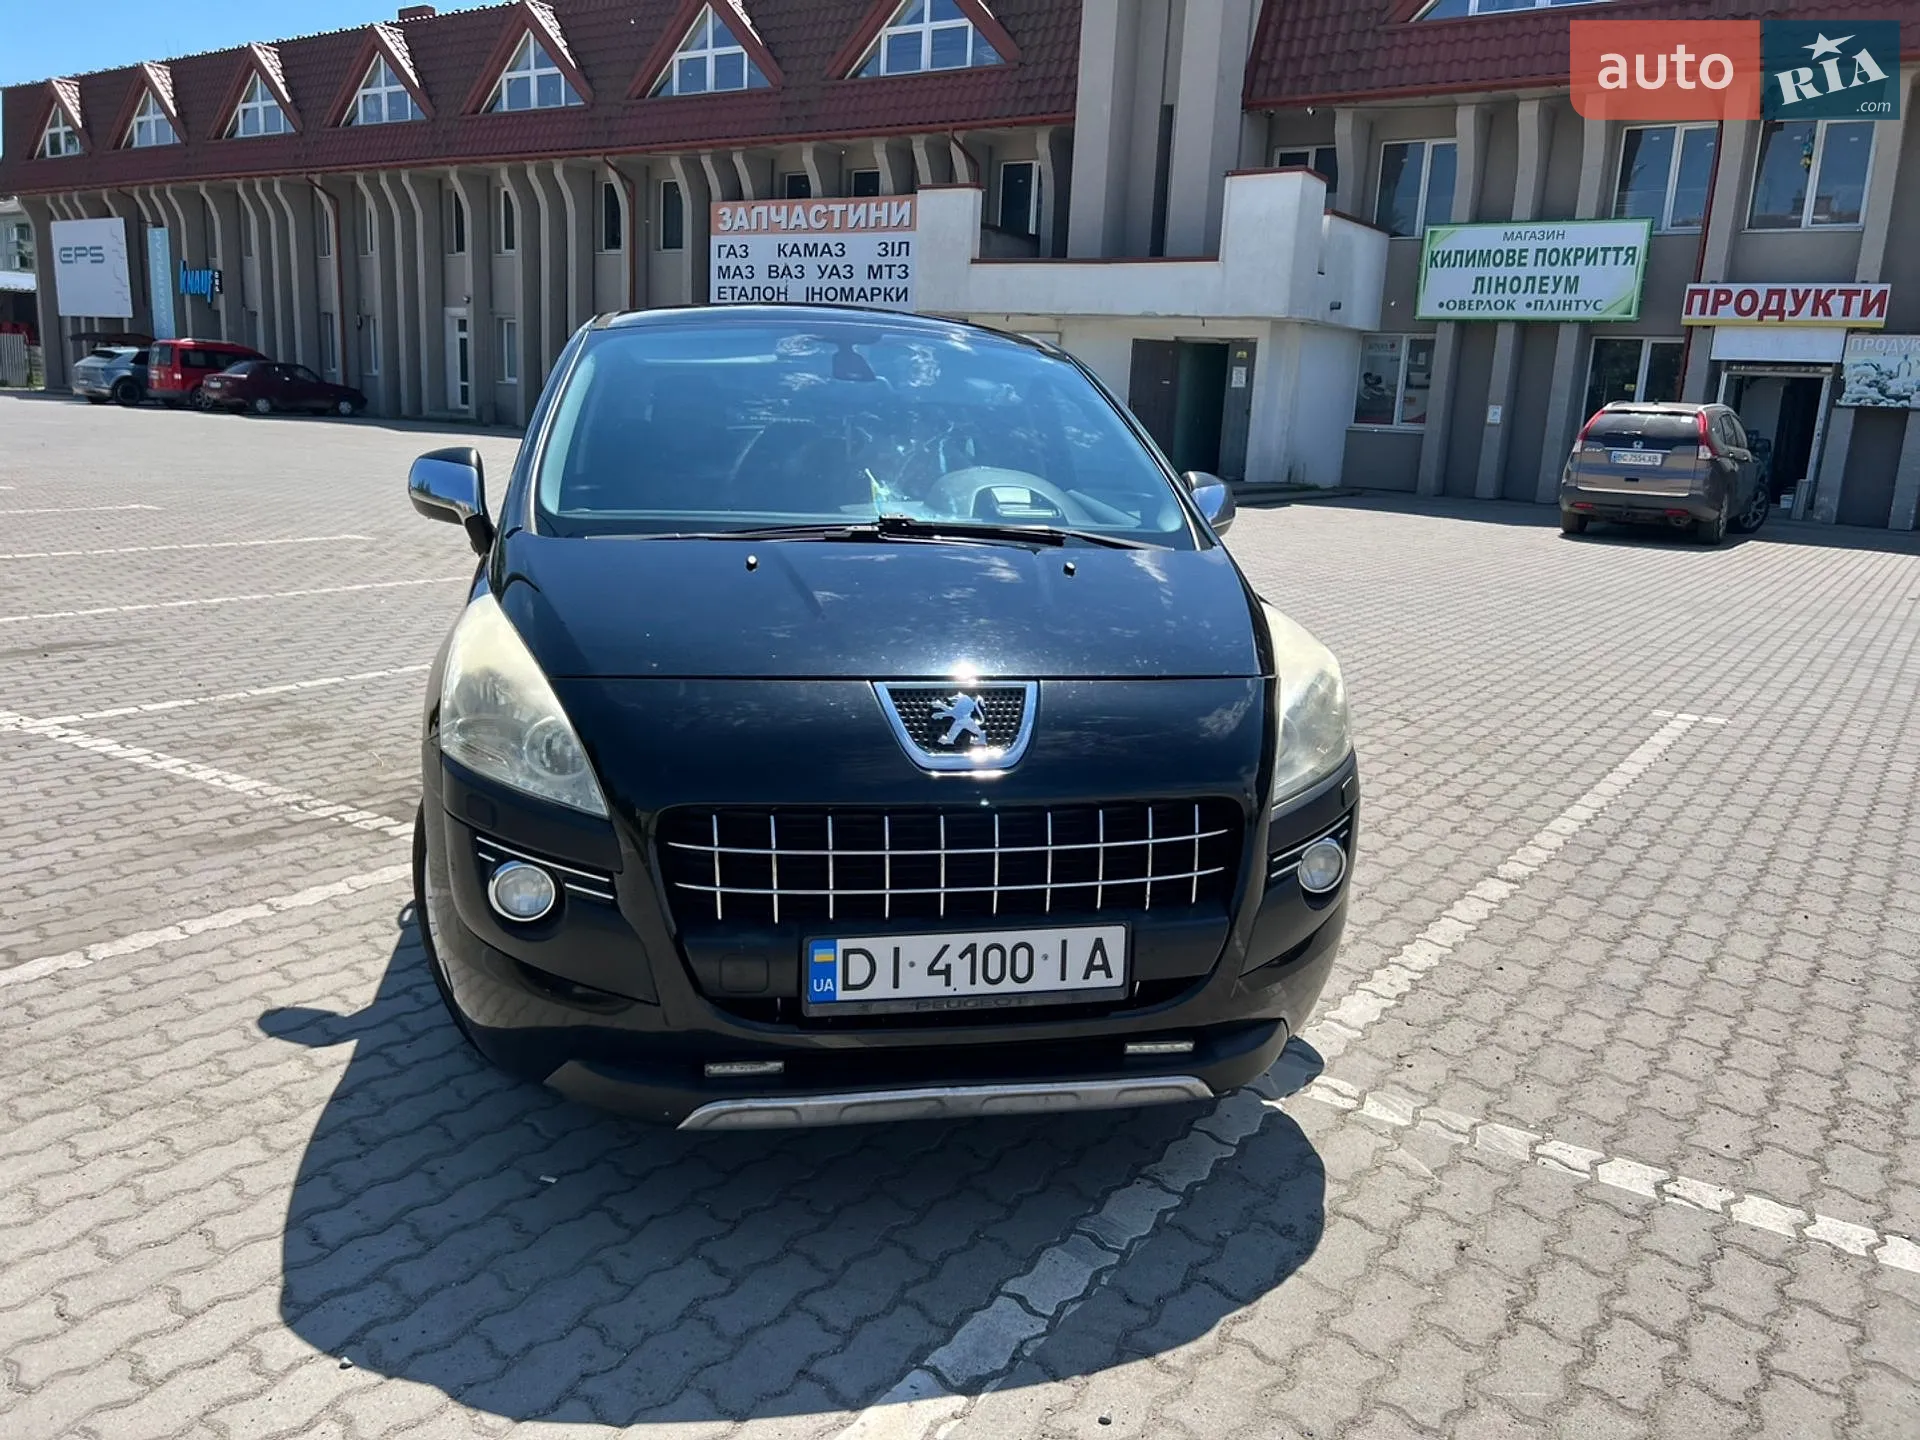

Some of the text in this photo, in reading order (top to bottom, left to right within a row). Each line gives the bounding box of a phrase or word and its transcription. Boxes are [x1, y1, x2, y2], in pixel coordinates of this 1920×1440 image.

[717, 200, 912, 231] ЗАПЧАСТИНИ
[1502, 230, 1566, 242] МАГАЗИН
[59, 246, 105, 264] EPS
[717, 241, 910, 259] ГАЗ КАМАЗ ЗІЛ
[1429, 246, 1637, 268] КИЛИМОВЕ ПОКРИТТЯ
[717, 264, 909, 280] МАЗ ВАЗ УАЗ МТЗ
[179, 260, 213, 303] KNAUF
[1471, 275, 1580, 295] ЛІНОЛЕУМ
[717, 286, 908, 302] ЕТАЛОН ІНОМАРКИ
[1684, 288, 1889, 322] ПРОДУКТИ
[841, 937, 1114, 992] DI 4100 IA
[813, 978, 835, 993] UA
[915, 997, 1027, 1010] PEUGEOT
